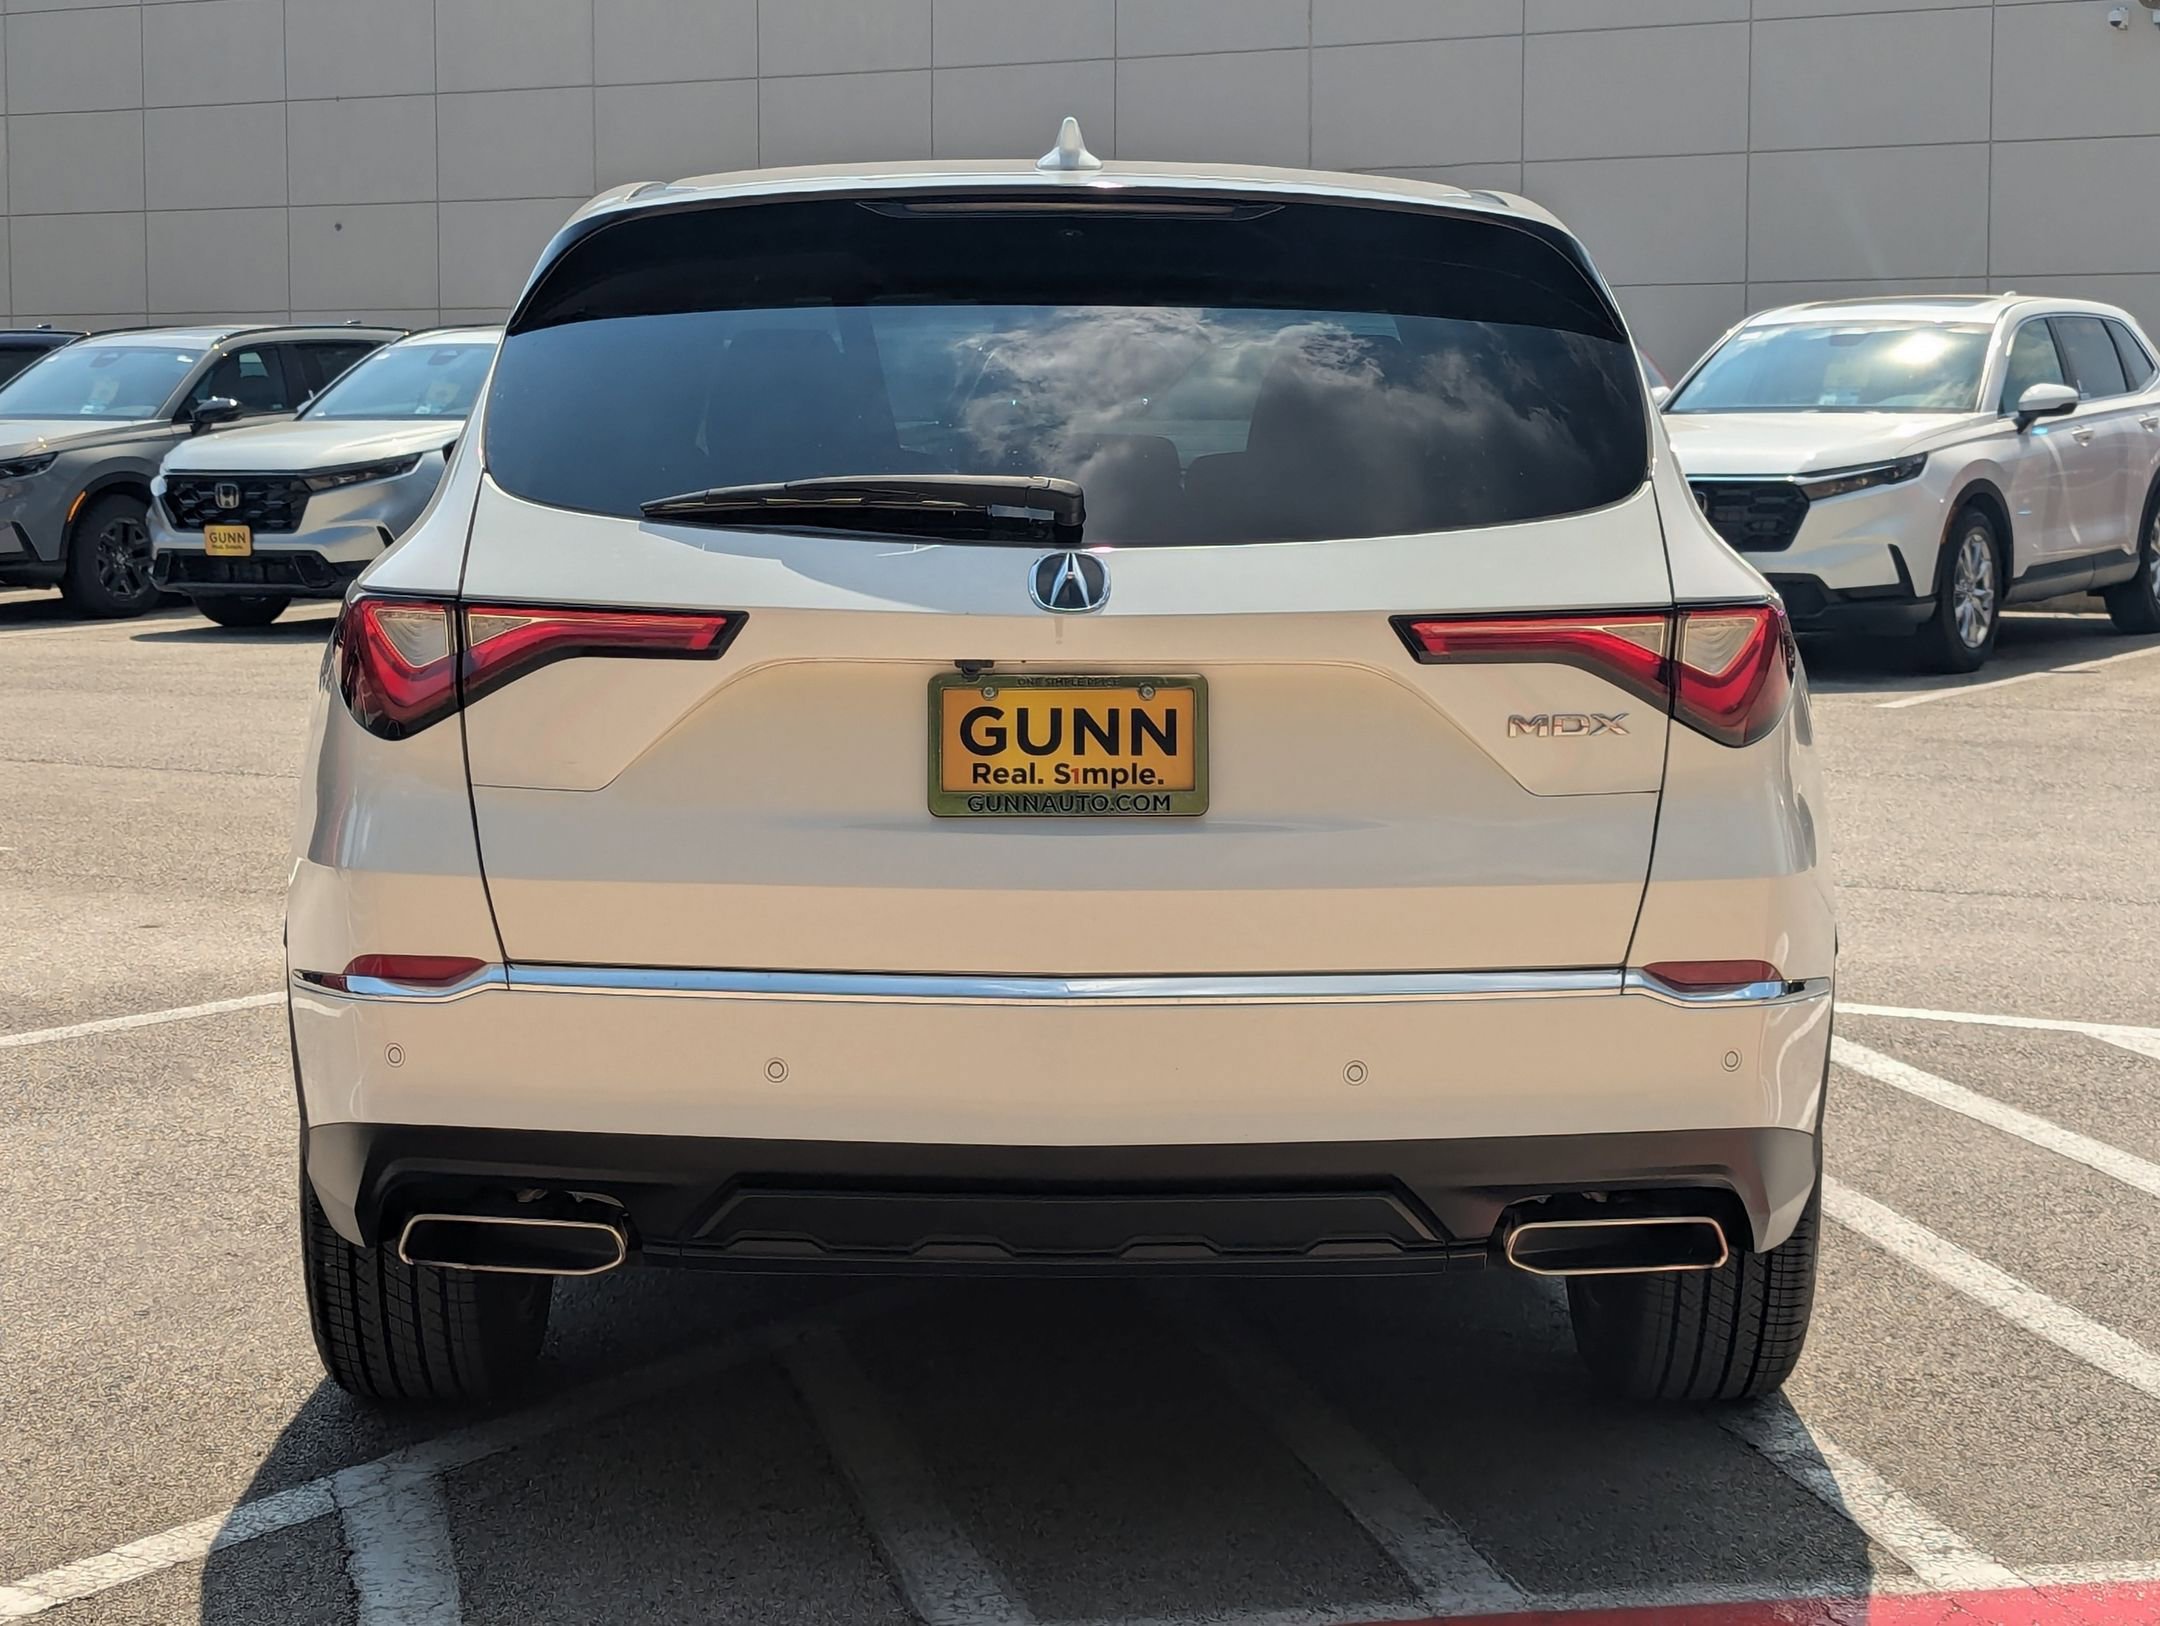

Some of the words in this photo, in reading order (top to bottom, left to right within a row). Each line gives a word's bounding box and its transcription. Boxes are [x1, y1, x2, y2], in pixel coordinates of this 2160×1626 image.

[209, 532, 247, 544] GUNN
[959, 706, 1177, 756] GUNN
[1507, 712, 1630, 738] MDX
[972, 762, 1044, 785] Real.
[967, 795, 1171, 812] GUNNAUTO.COM
